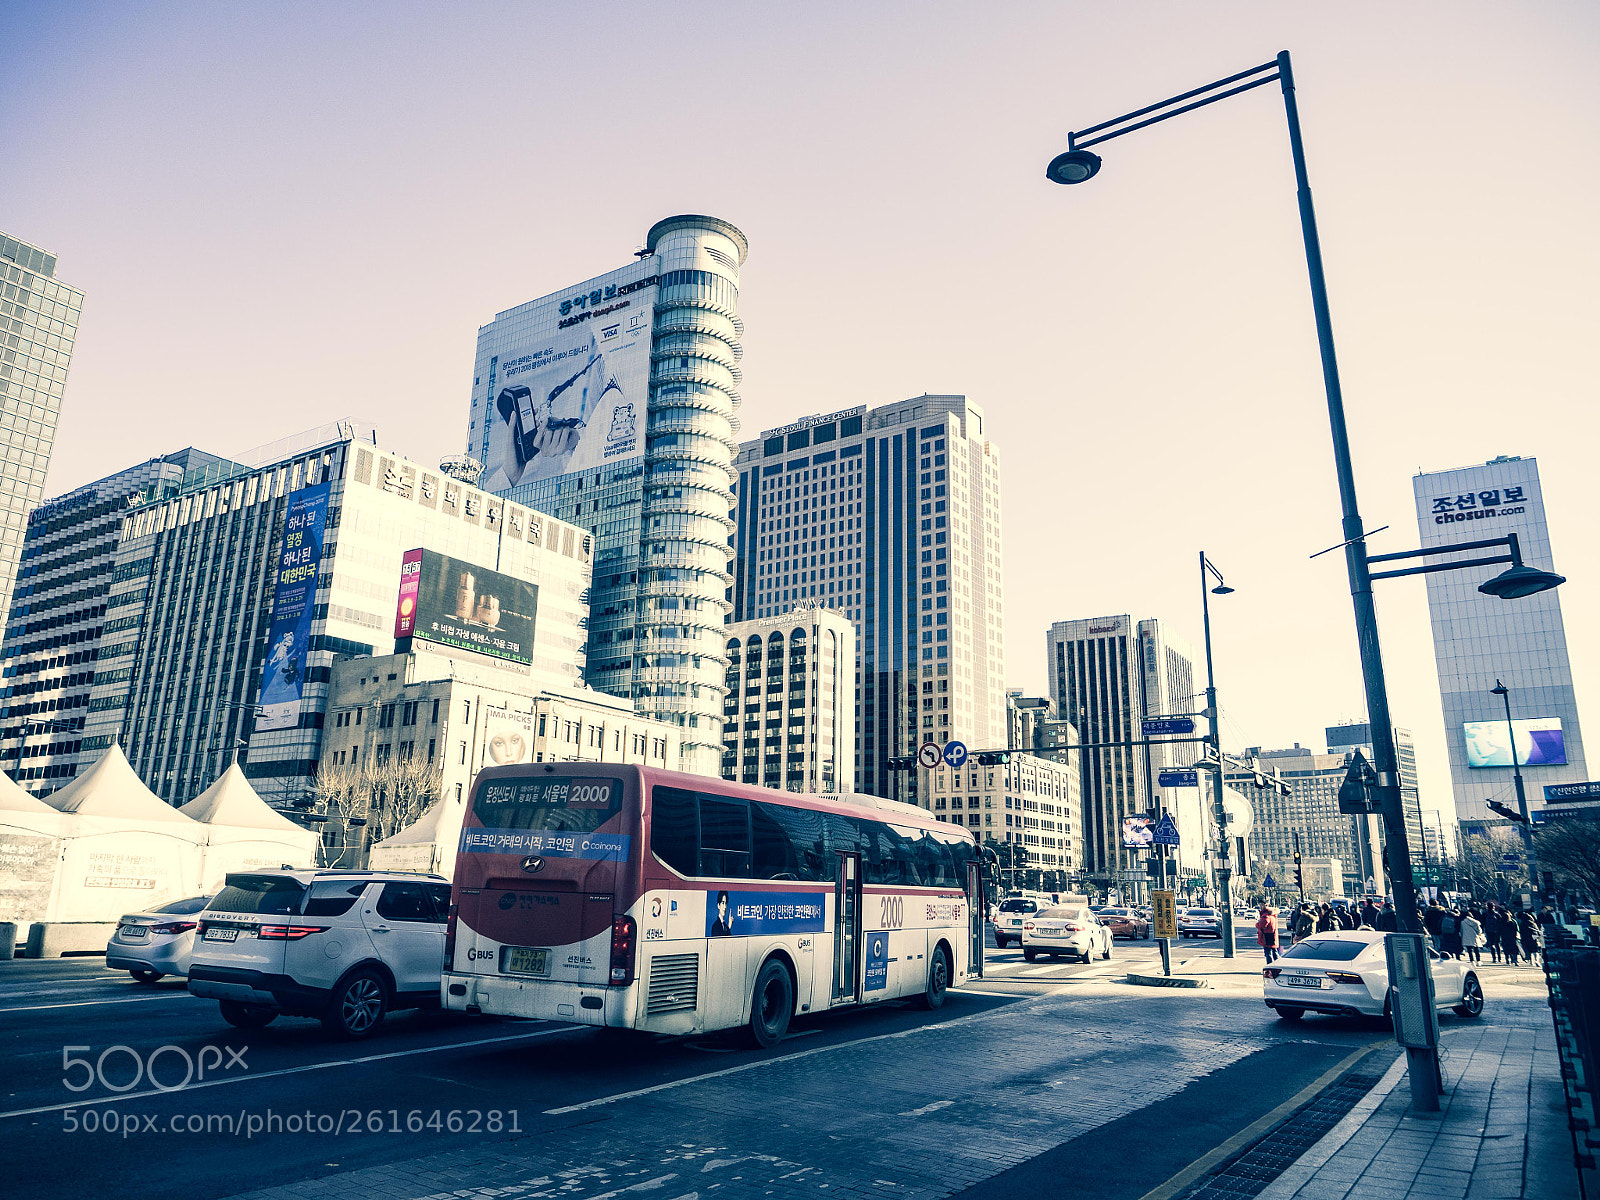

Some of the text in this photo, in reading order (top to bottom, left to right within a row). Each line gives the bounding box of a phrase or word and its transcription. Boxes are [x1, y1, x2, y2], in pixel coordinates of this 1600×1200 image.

[558, 283, 618, 315] 동아일보
[603, 329, 618, 339] VISA
[781, 408, 859, 435] SEOUL FINANCE CENTER
[1431, 486, 1528, 513] 조선일보
[1435, 506, 1525, 525] chosun.com
[286, 531, 304, 549] 열정
[280, 562, 317, 585] 대한민국
[1088, 625, 1117, 634] kobaco
[456, 627, 470, 640] 자생
[507, 641, 520, 653] 크림
[489, 710, 532, 724] IMA PICKS
[518, 793, 539, 803] 광화문
[542, 784, 570, 803] 서울역
[570, 785, 610, 802] 2000
[1557, 785, 1587, 796] 신한은행
[465, 833, 497, 848] 비트코인
[497, 834, 524, 849] 거래의
[545, 837, 575, 852] 코인원
[590, 842, 622, 851] coinone
[209, 913, 255, 921] DISCOVERY
[764, 905, 777, 920] 가장
[777, 905, 794, 919] 안전한
[880, 896, 904, 928] 2000
[567, 955, 592, 964] 선진버스
